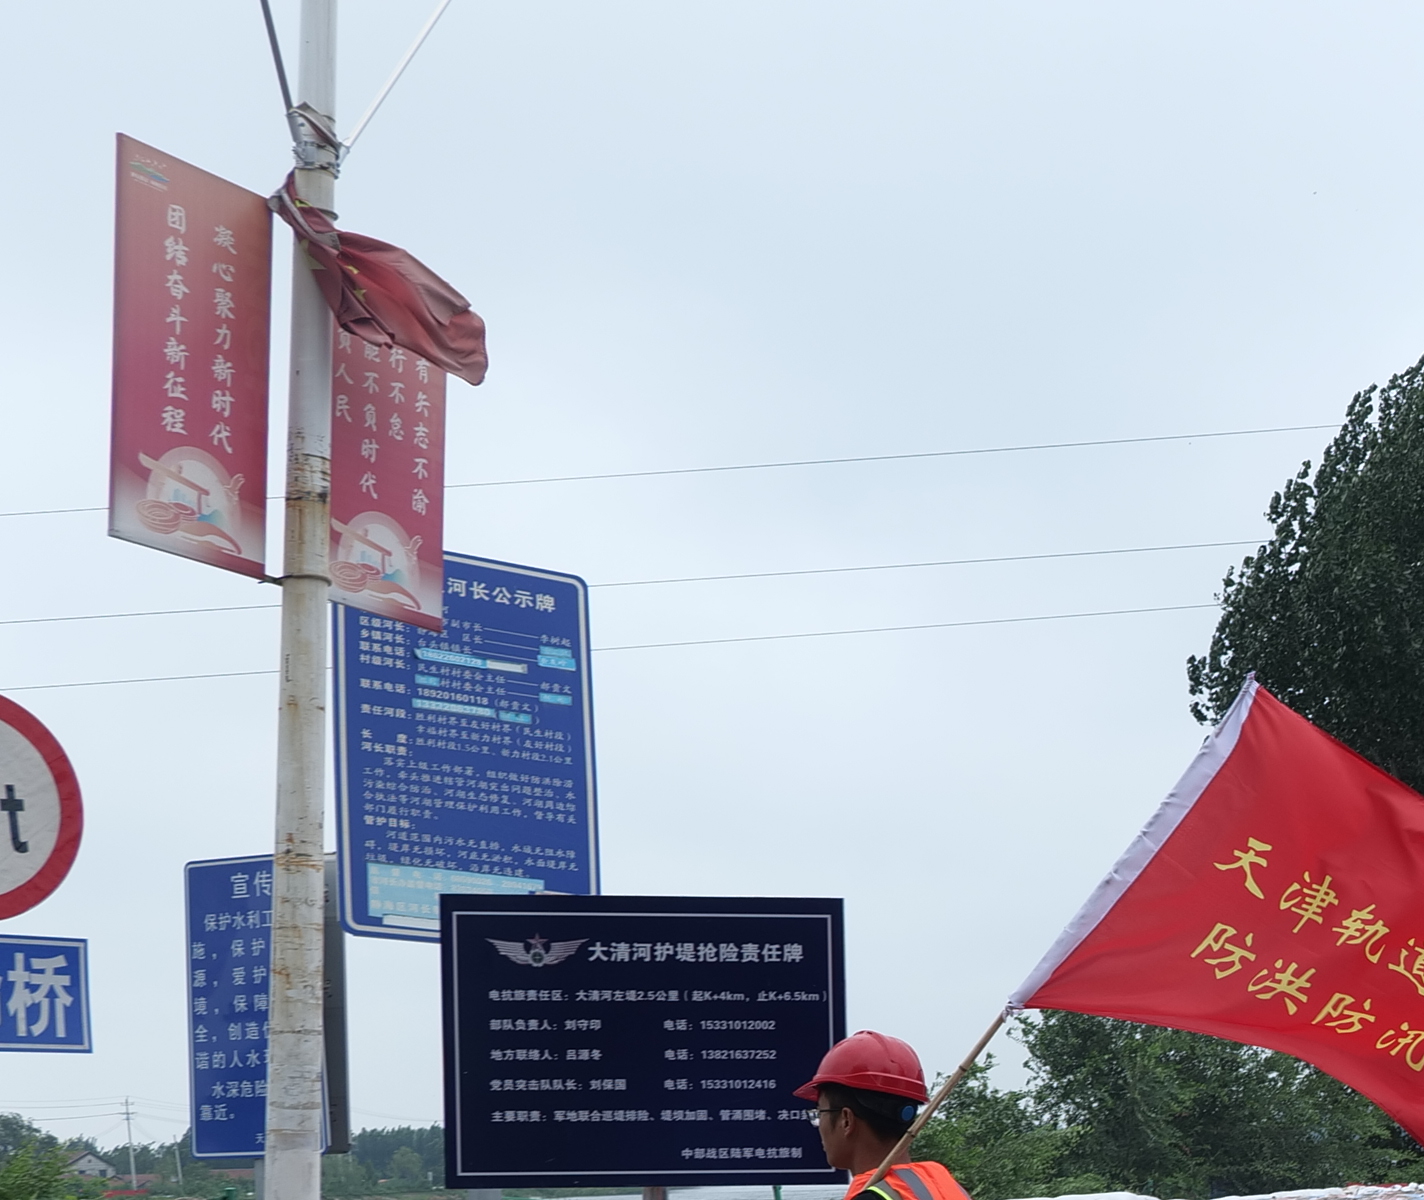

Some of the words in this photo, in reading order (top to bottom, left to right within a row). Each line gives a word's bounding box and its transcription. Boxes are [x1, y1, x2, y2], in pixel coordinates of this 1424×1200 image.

[161, 204, 190, 435] 团结奋斗新征程
[208, 224, 237, 453] 凝心聚力新时代
[442, 577, 557, 613] 河长公示牌
[0, 952, 74, 1038] 桥
[587, 941, 804, 963] 大清河护堤抢险责任牌
